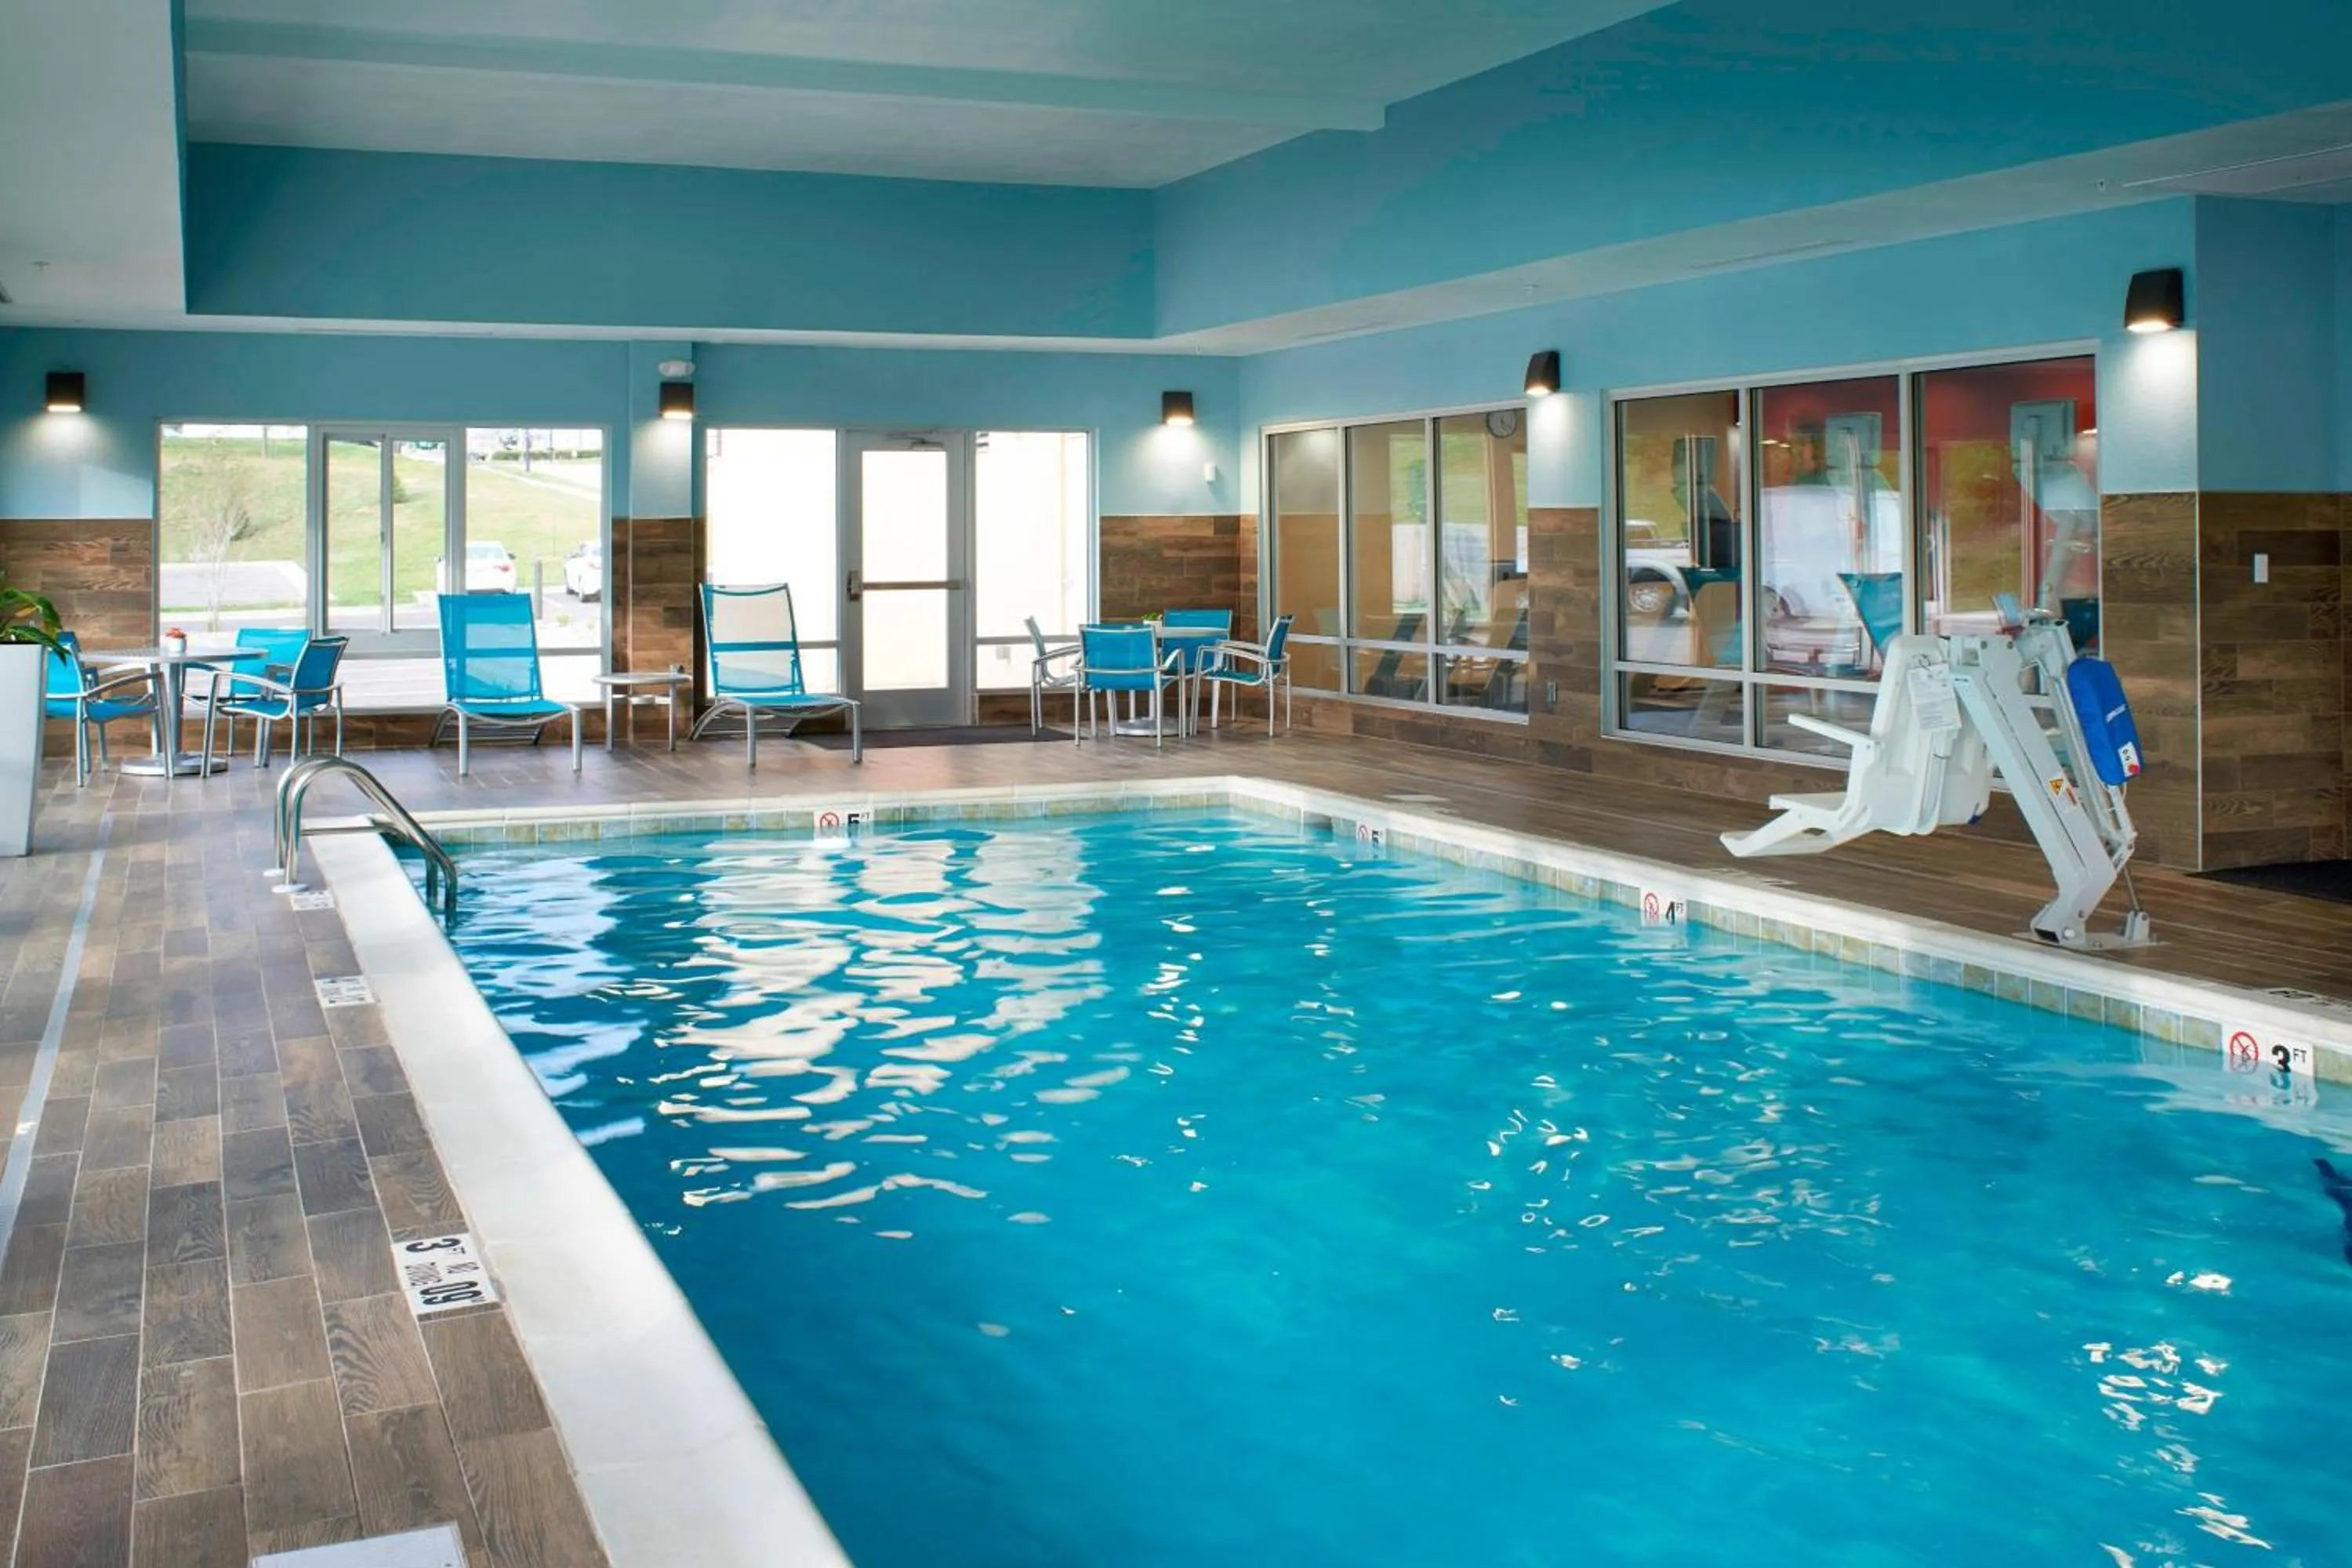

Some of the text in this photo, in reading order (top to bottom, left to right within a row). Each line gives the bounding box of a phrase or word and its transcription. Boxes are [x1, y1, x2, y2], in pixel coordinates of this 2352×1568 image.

[1666, 901, 1675, 924] 4
[2271, 1044, 2307, 1074] 3 FT
[405, 1238, 461, 1253] 3
